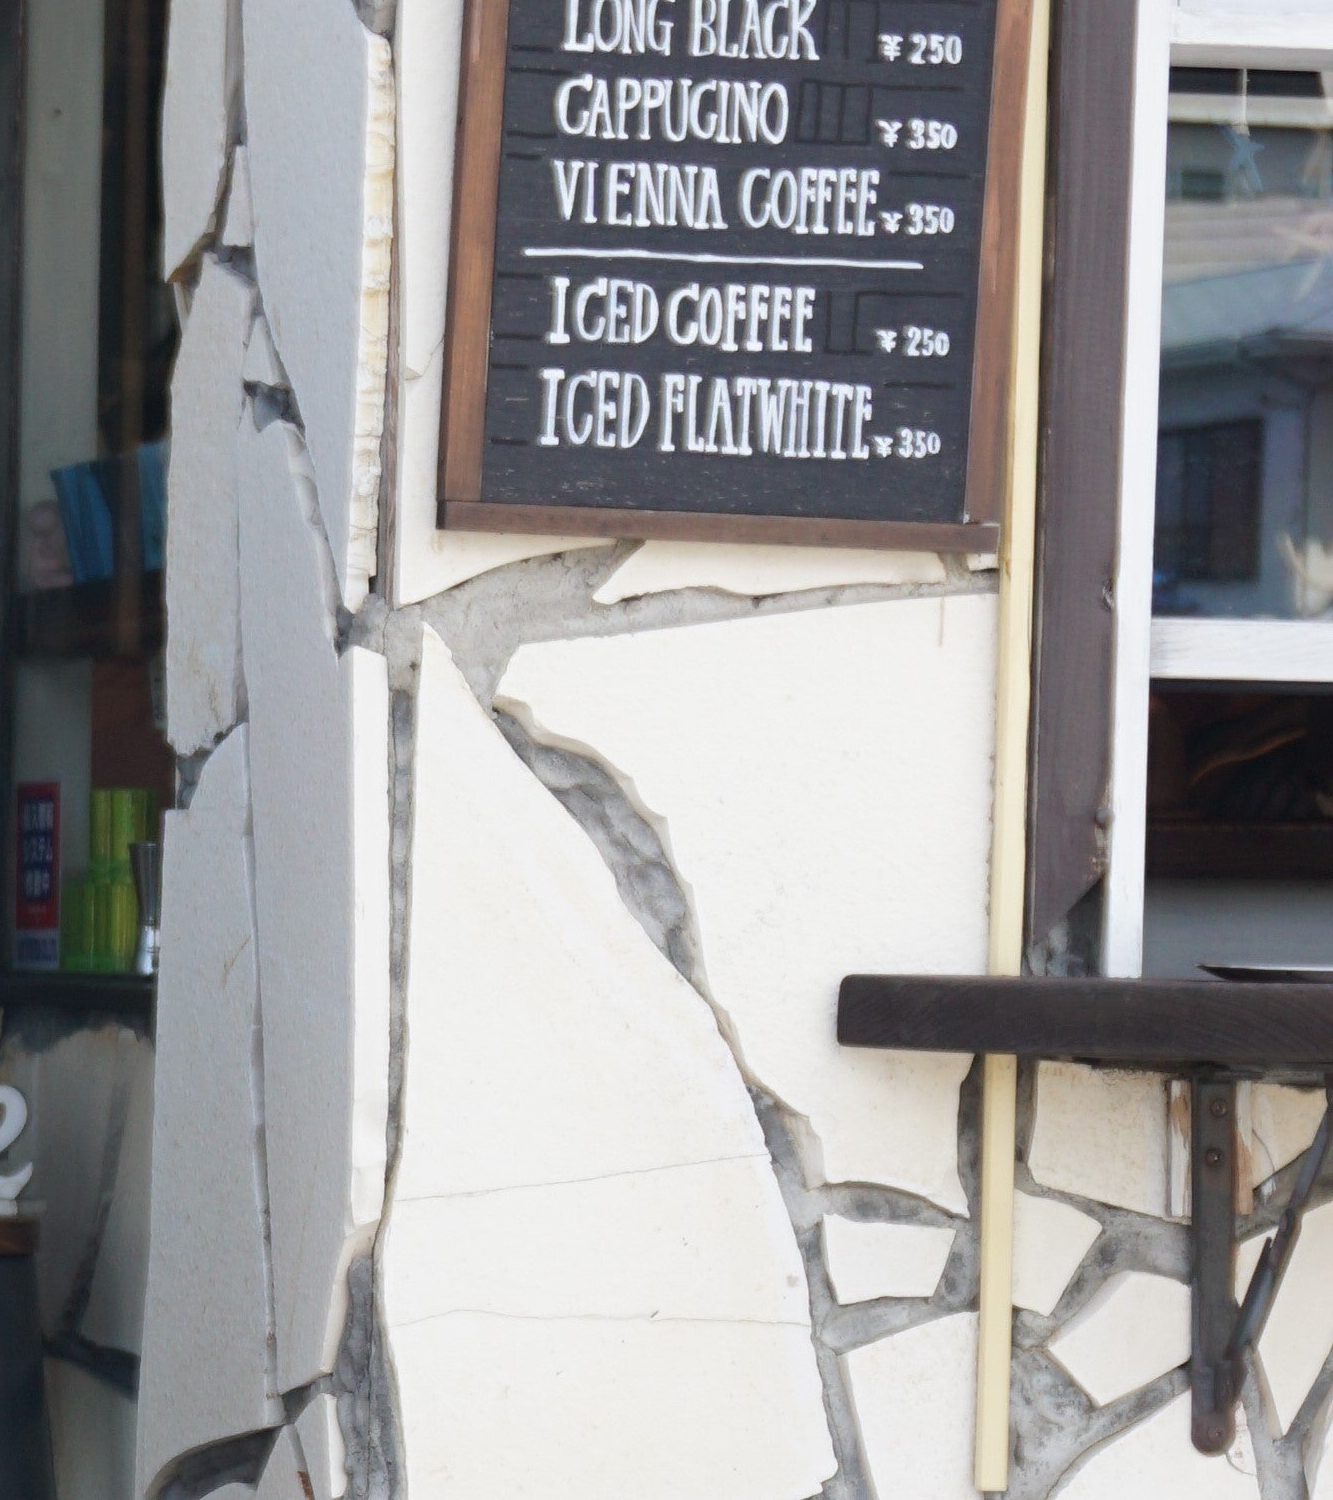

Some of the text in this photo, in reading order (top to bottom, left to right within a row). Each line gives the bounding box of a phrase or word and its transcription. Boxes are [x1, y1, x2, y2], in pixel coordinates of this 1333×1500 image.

[554, 73, 790, 145] CAPPUCINO
[552, 158, 729, 230] VIENNA
[739, 167, 880, 237] COFFEE
[546, 276, 660, 345] ICED
[664, 282, 816, 352] COFFEE
[539, 368, 651, 450] ICED
[658, 372, 873, 460] FLATWHITE
